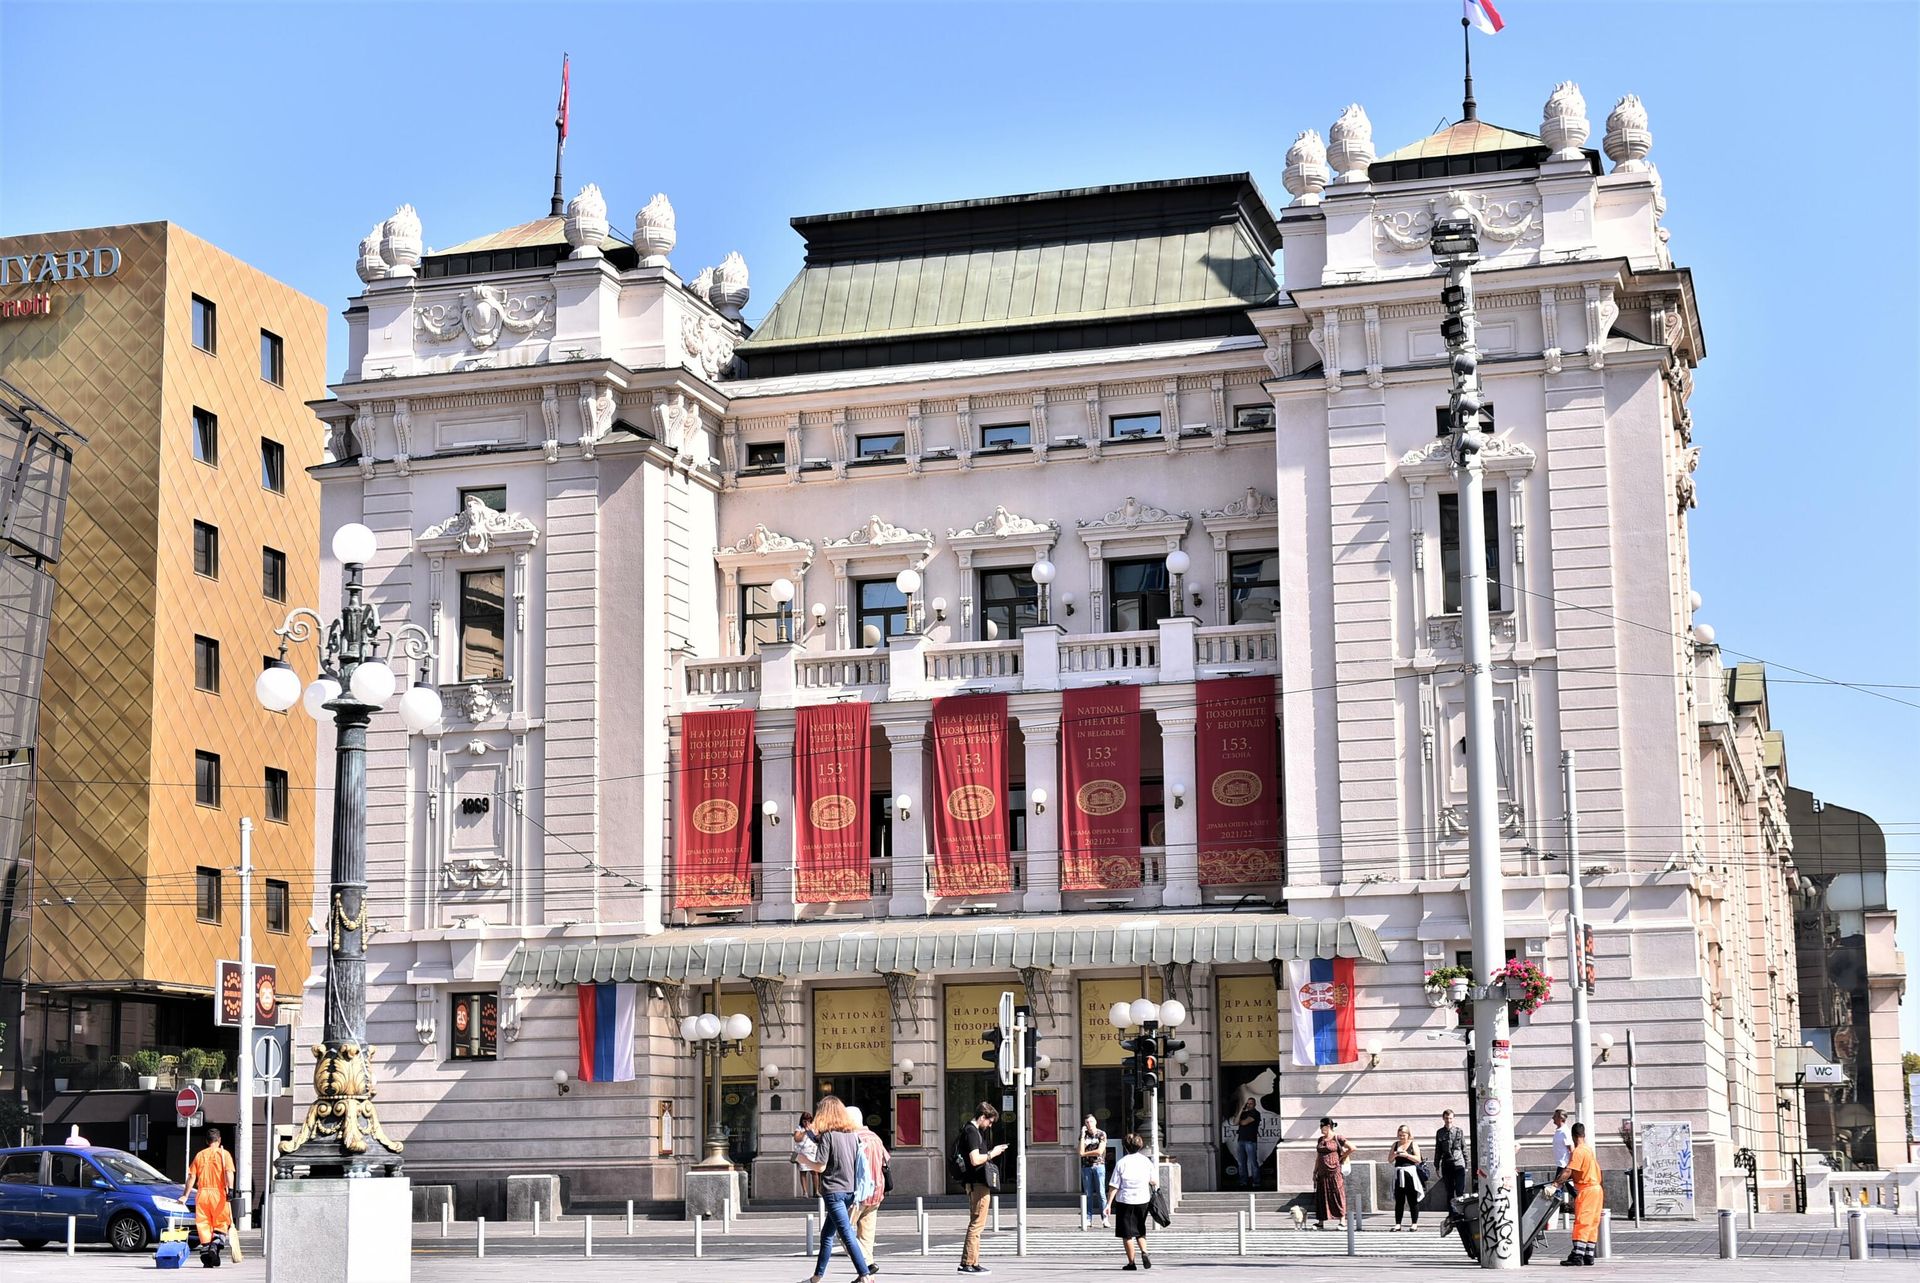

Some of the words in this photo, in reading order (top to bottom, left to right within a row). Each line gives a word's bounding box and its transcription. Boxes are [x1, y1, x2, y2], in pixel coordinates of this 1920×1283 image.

[1205, 696, 1266, 708] НАРОДНО
[1077, 705, 1125, 715] NATIONAL
[1205, 707, 1266, 719] ПОЗОРИШТЕ
[941, 712, 999, 724] НАРОДНО
[1078, 716, 1126, 727] THEATRE
[1206, 722, 1212, 730] У
[1217, 719, 1266, 730] БЕОГРАДУ
[690, 728, 746, 739] НАРОДНО
[1087, 729, 1126, 737] BELGRADE
[690, 739, 745, 750] ПОЗОРИШТЕ
[941, 738, 947, 746] У
[953, 734, 1000, 745] БЕОГРАДУ
[1222, 737, 1252, 751] 153.
[700, 750, 745, 760] БЕОГРАДУ
[957, 753, 985, 767] 153.
[1086, 760, 1116, 768] SEASON
[704, 767, 730, 781] 153.
[1224, 1000, 1273, 1009] ДРАМА
[821, 1011, 886, 1020] NATIONAL
[1224, 1015, 1273, 1023] ОПЕРА
[821, 1025, 886, 1035] THEATRE
[1225, 1030, 1273, 1039] БАЛЕТ
[835, 1041, 886, 1050] BELGRADE
[1814, 1067, 1833, 1076] WC
